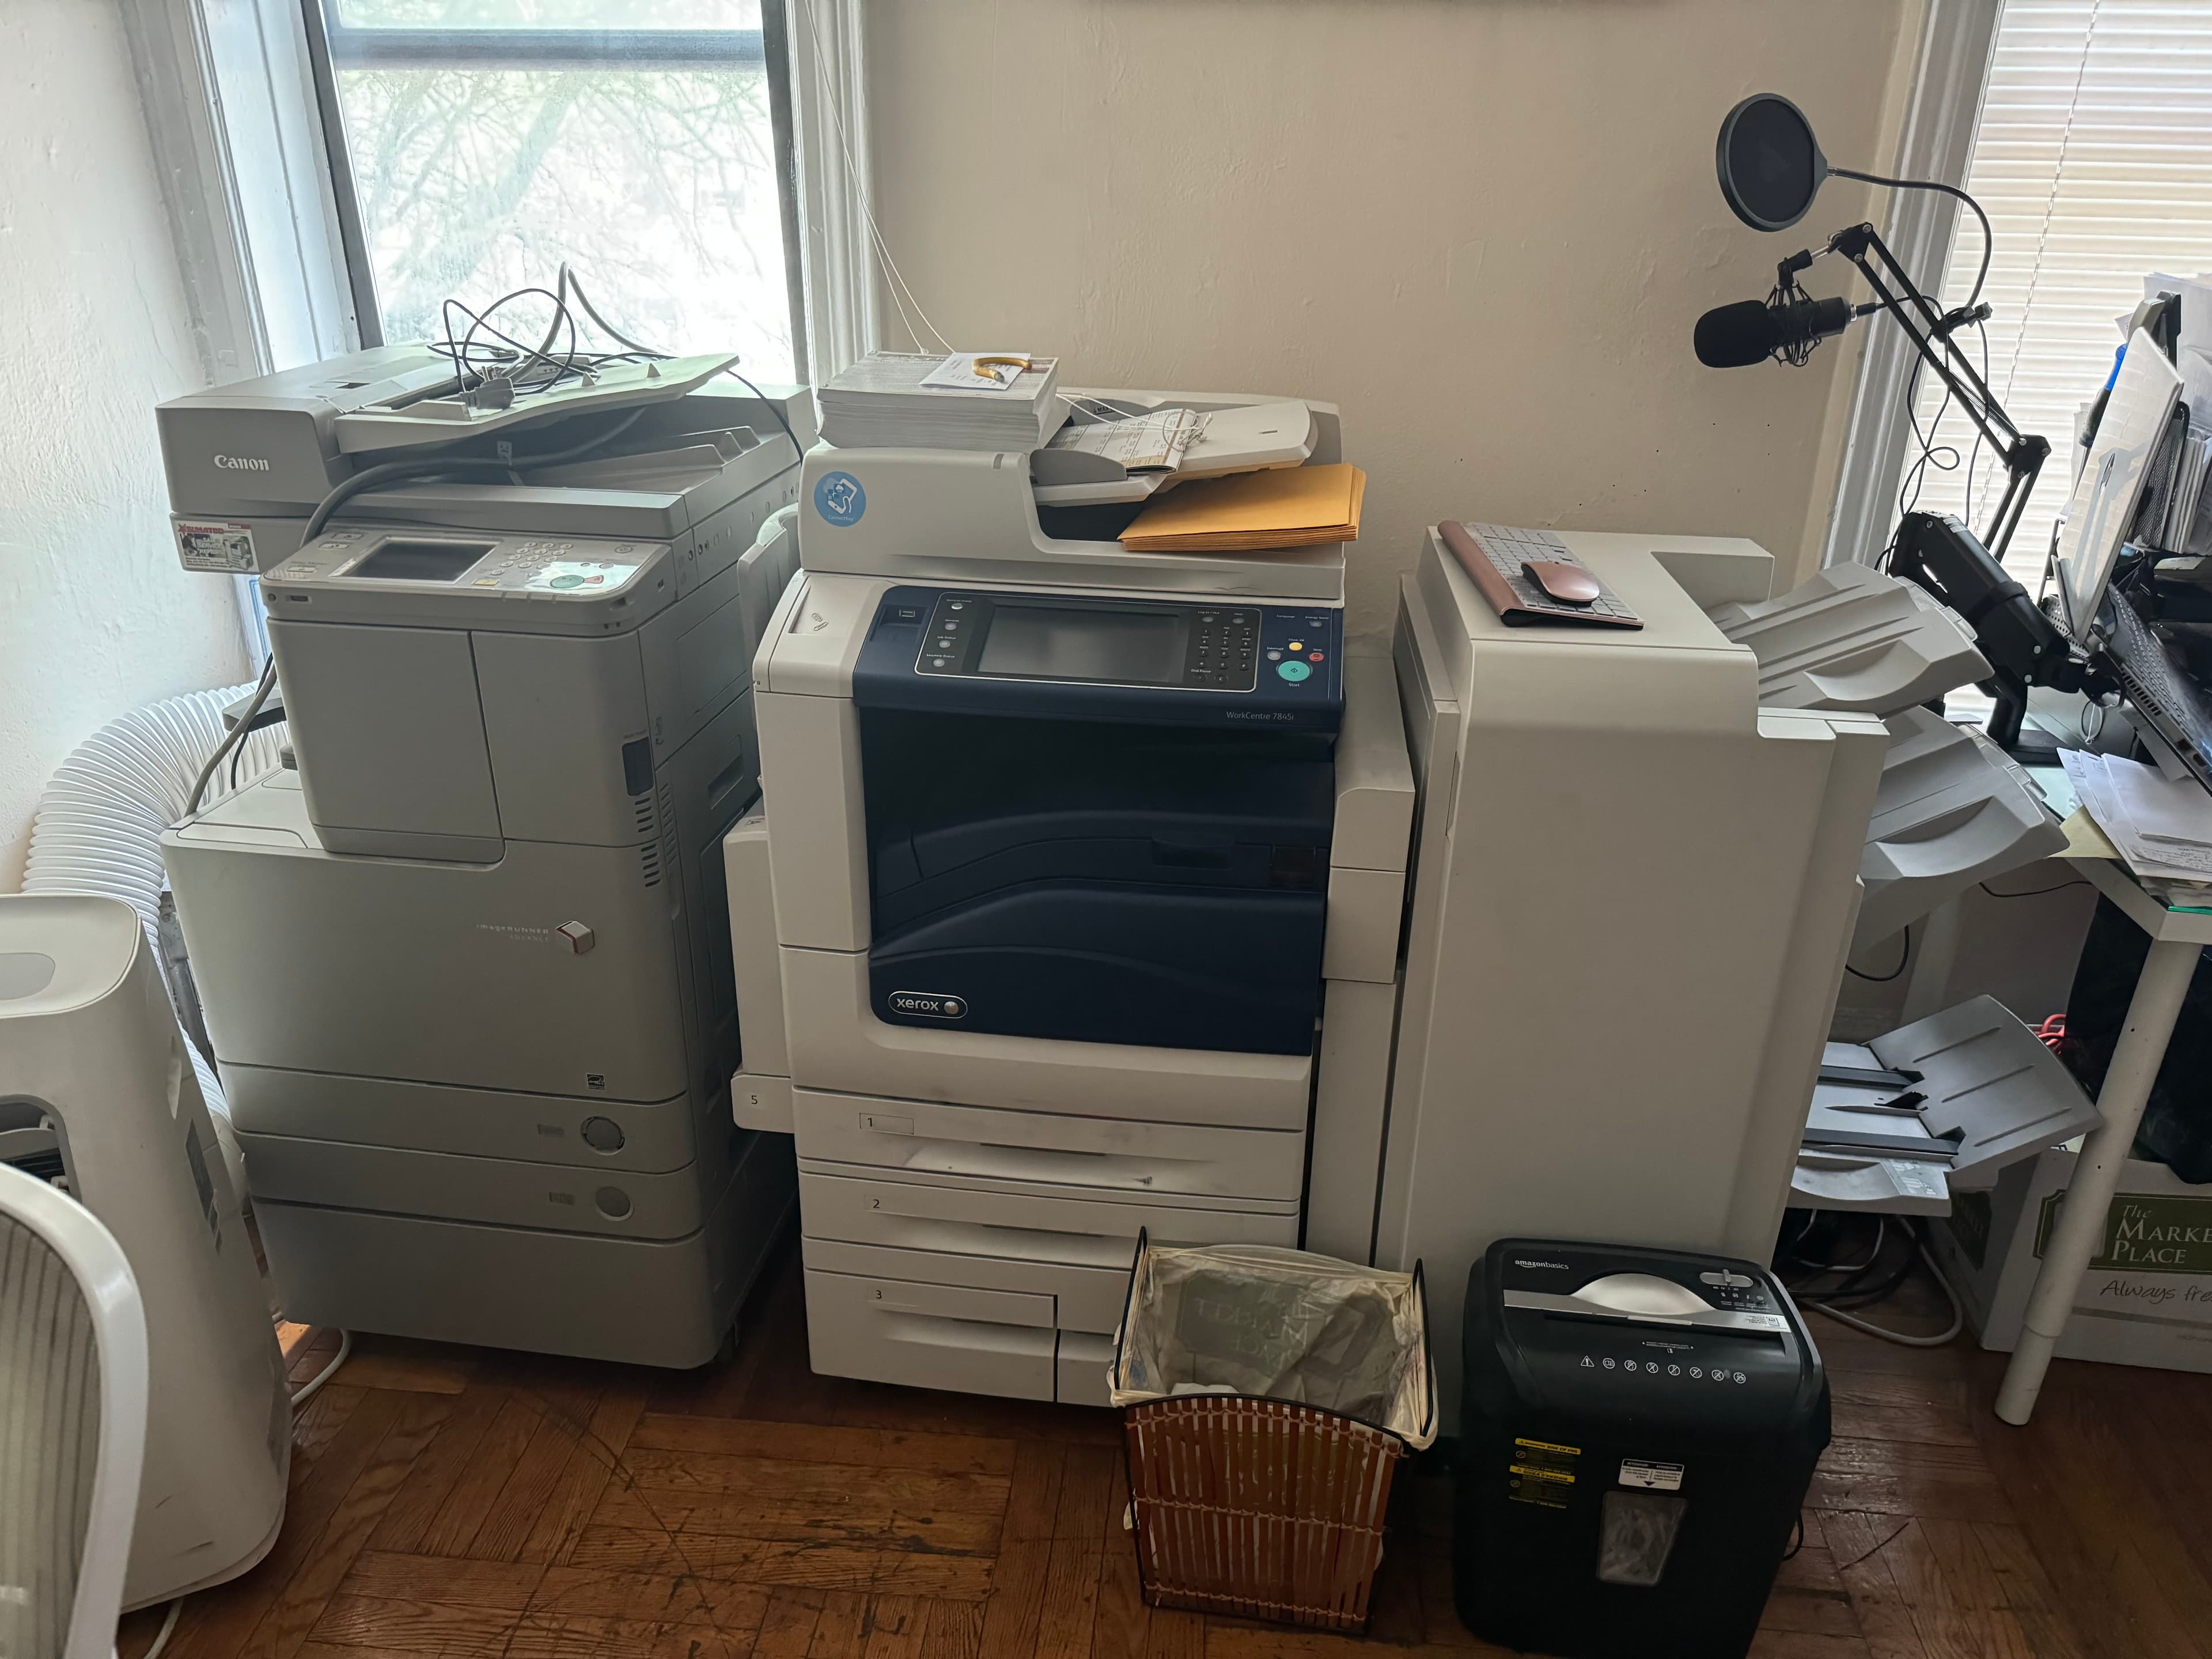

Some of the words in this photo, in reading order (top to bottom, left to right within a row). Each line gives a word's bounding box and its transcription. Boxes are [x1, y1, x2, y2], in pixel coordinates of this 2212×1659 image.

[214, 454, 270, 471] Canon
[1226, 711, 1271, 719] WorkCentre
[1272, 713, 1294, 721] 7845i
[896, 998, 940, 1012] xerox
[751, 1095, 758, 1105] 5
[867, 1118, 873, 1127] 1
[873, 1199, 880, 1209] 2
[2122, 1204, 2153, 1218] The
[2110, 1240, 2188, 1264] PLACE
[1514, 1259, 1569, 1270] amazonbasics
[876, 1290, 882, 1300] 3
[2100, 1280, 2177, 1305] Always
[2184, 1285, 2212, 1302] fre
